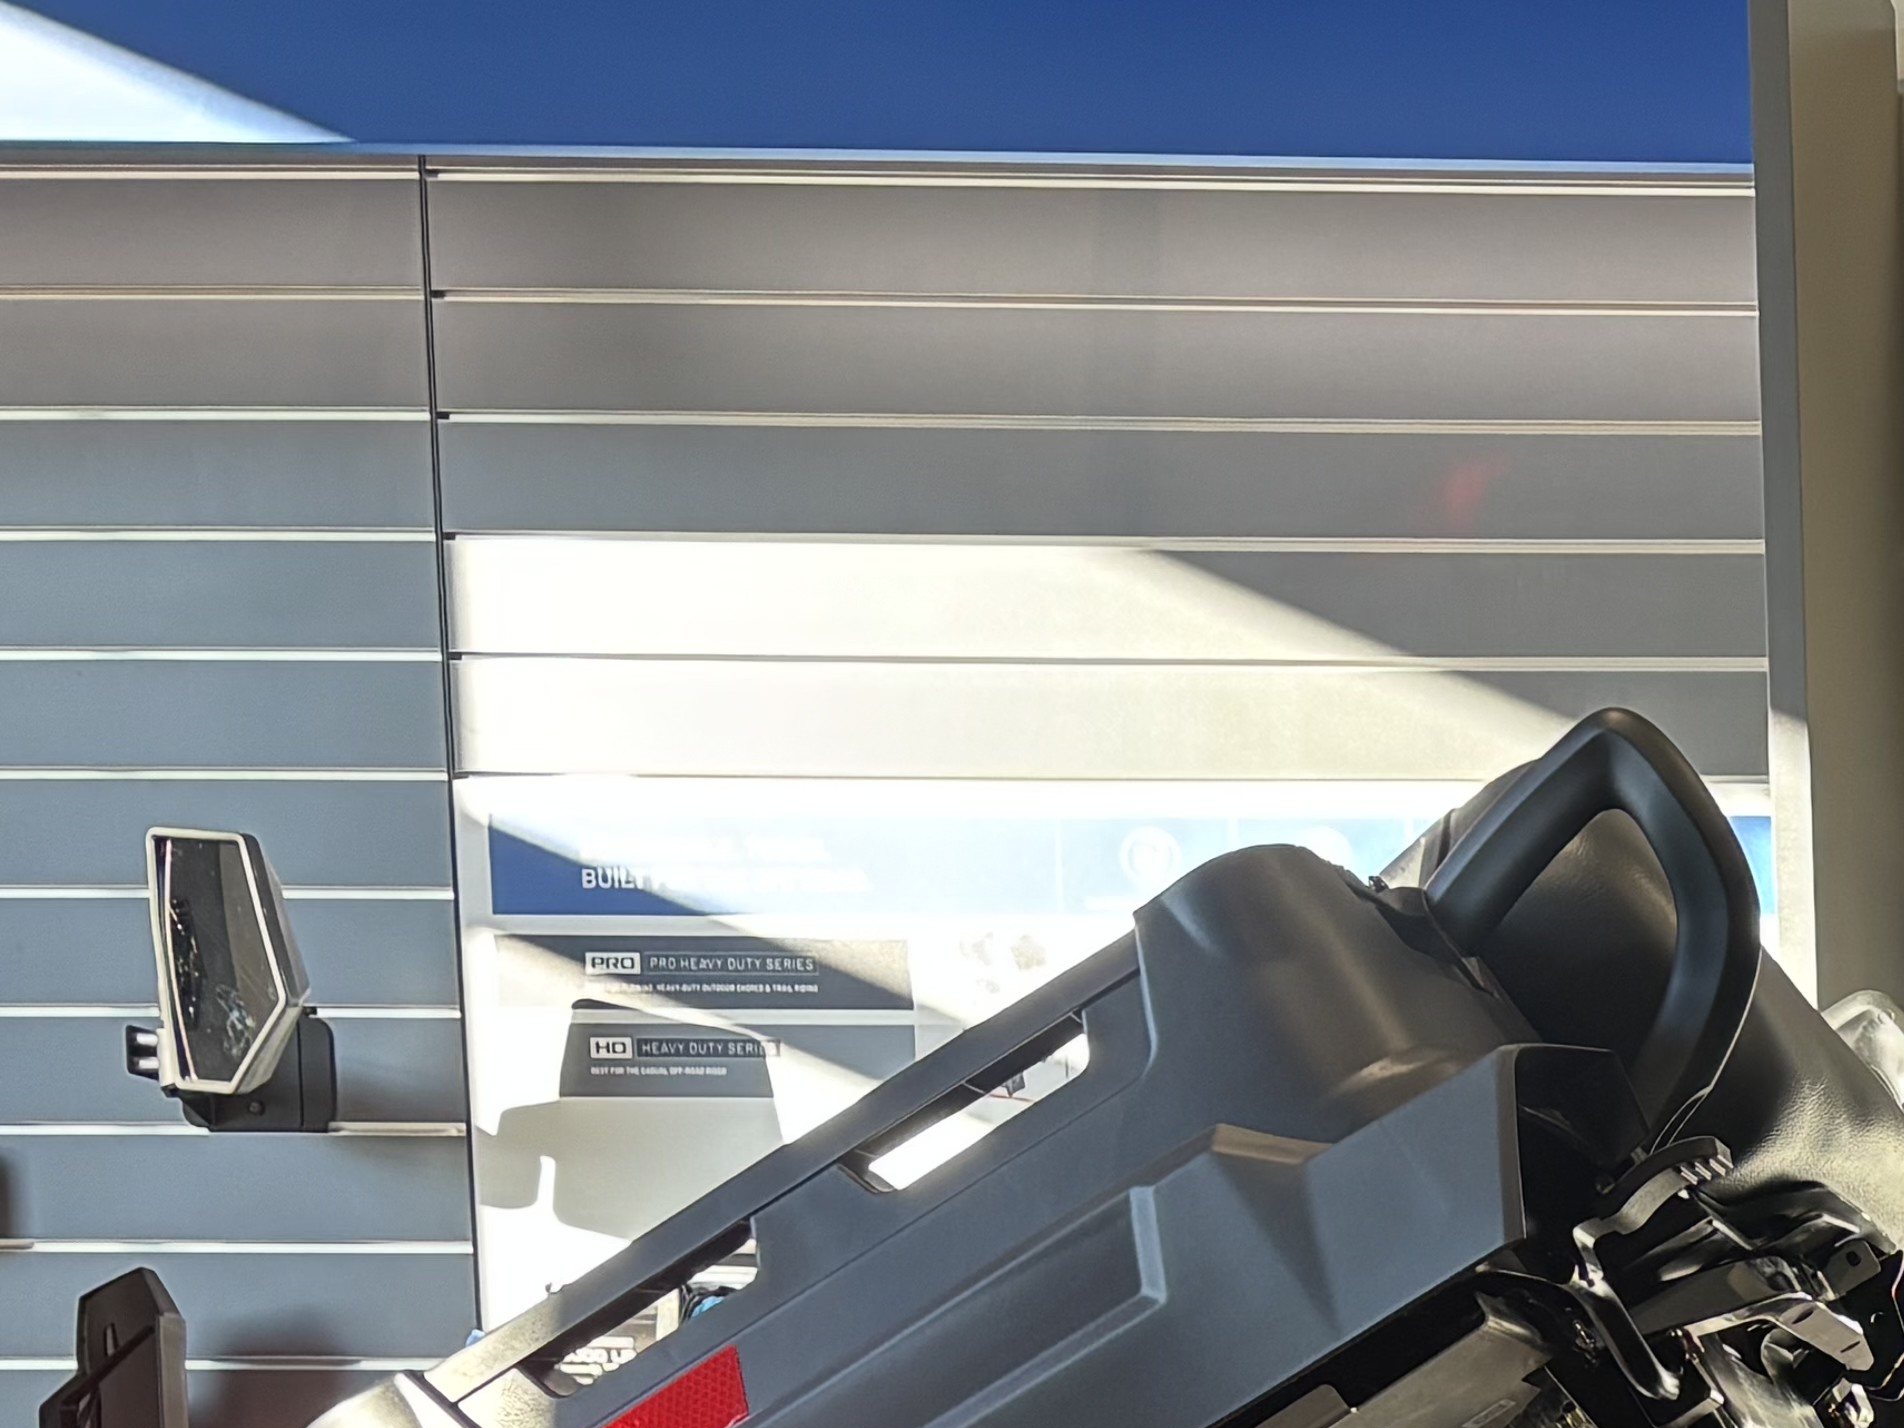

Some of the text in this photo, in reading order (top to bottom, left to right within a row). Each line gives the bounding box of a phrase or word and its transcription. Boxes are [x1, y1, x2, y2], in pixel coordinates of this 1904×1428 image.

[590, 956, 636, 970] PRO
[650, 957, 814, 970] PRO HEAVY DUTY SERIES
[595, 1040, 628, 1055] HD
[642, 1042, 684, 1055] HEAVY
[688, 1042, 723, 1055] DUTY
